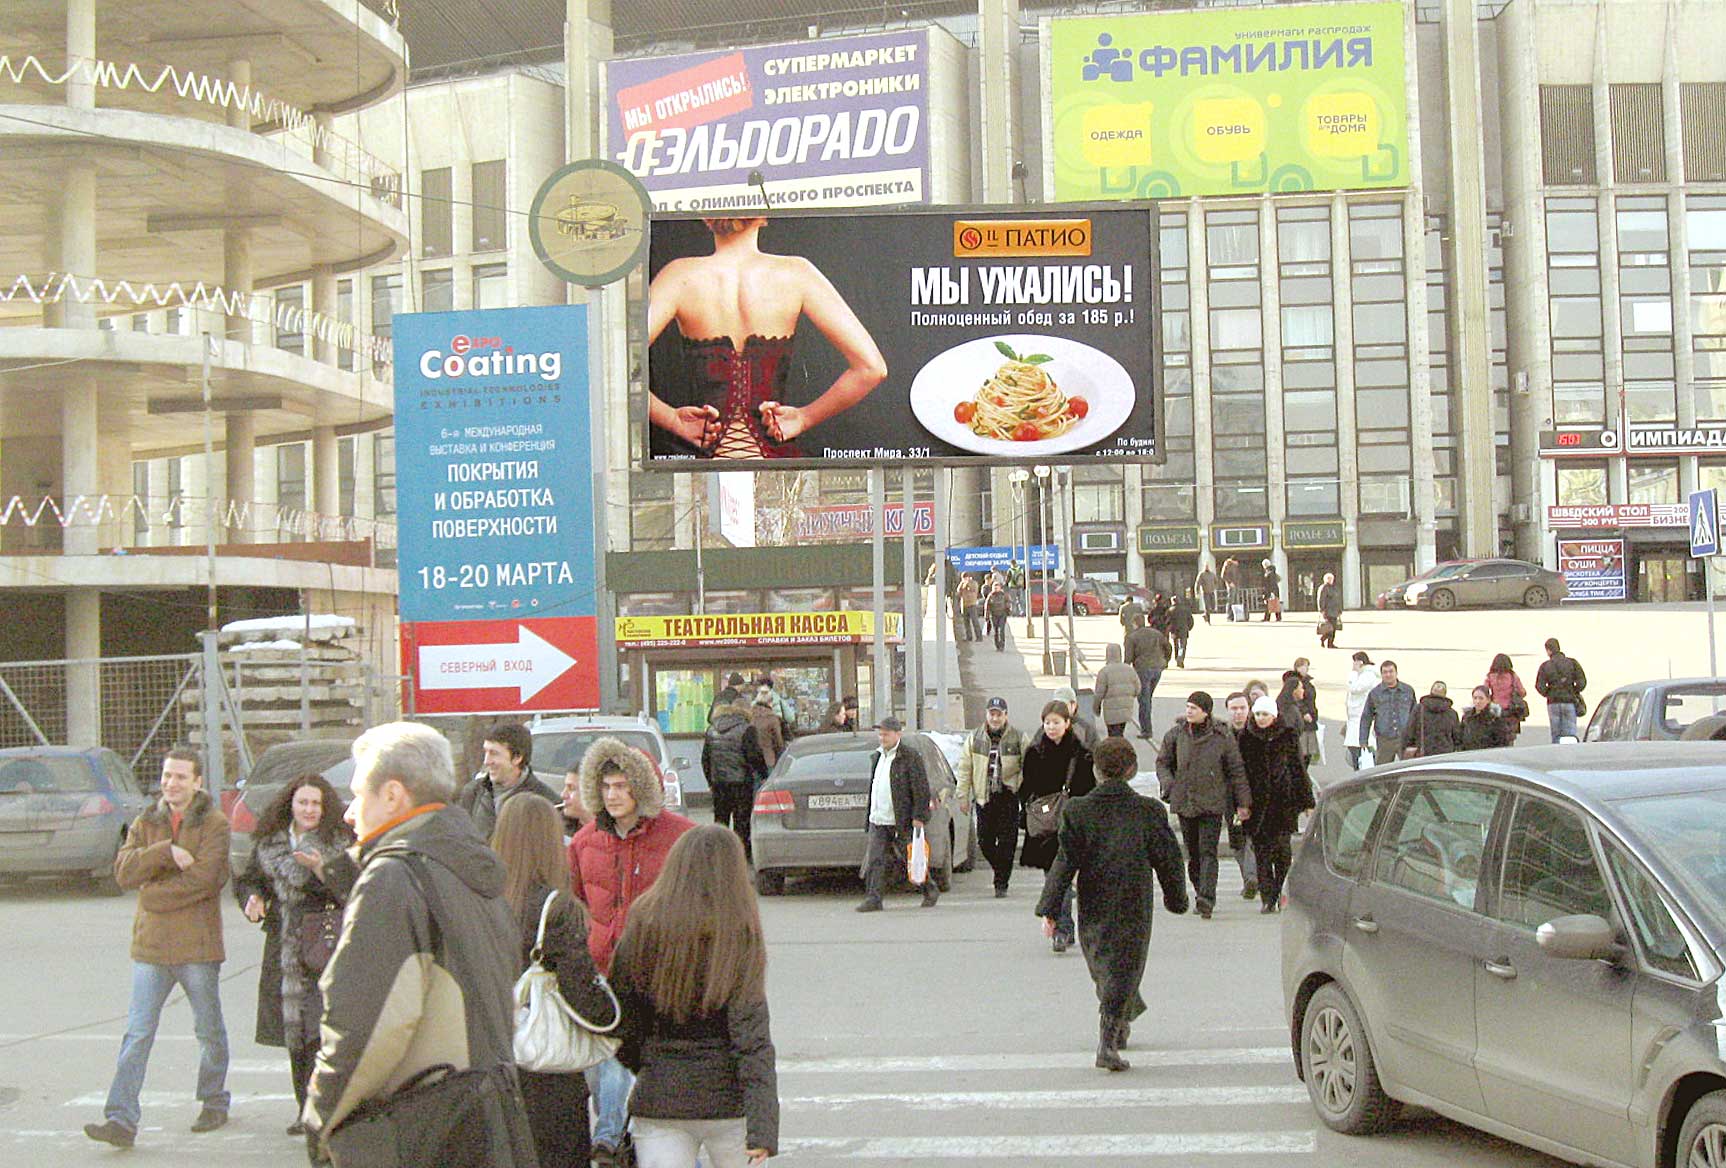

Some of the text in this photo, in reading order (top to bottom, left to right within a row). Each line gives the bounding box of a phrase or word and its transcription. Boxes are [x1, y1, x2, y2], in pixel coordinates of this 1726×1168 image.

[764, 45, 917, 76] СУПЕРМАРКЕТ
[1139, 37, 1373, 77] ФАМИЛИЯ
[764, 74, 920, 105] ЭЛЕКТРОНИКИ
[624, 72, 746, 130] МЫ ОТКРЫЛИСЬ!
[1317, 114, 1367, 124] ТОВАРЫ
[1090, 128, 1143, 141] ОДЕЖДА
[1206, 124, 1251, 137] ОБУВЬ
[1330, 124, 1366, 134] ДОМА
[691, 188, 818, 211] ОЛИМПИЙСКОГО
[822, 181, 914, 202] ПРОСПЕКТА
[1005, 227, 1086, 247] ПАТИО
[911, 265, 1133, 305] МЫ УЖАЛИСЬ!
[911, 309, 1011, 327] Полноценный
[1017, 309, 1051, 326] обед
[1058, 312, 1076, 324] за
[1081, 309, 1108, 324] 185
[419, 346, 561, 380] Coating
[420, 396, 561, 409] EXHIBITIONS
[464, 423, 543, 438] МЕЖДУНАРОДНАЯ
[429, 439, 556, 456] ВЫСТАВКА И КОНФЕРЕНЦИЯ
[823, 447, 871, 459] Проспект
[908, 447, 930, 458] 33/1
[448, 461, 538, 482] ПОКРЫТИЯ
[434, 488, 554, 510] И ОБРАБОТКА
[1552, 505, 1648, 519] ШВЕДСКИЙ СТОЛ
[1673, 506, 1689, 514] 200
[432, 516, 557, 538] ПОВЕРХНОСТИ
[1653, 515, 1689, 525] БИЗНЕ
[1580, 545, 1615, 555] ПИЦЦА
[1568, 561, 1596, 570] СУШИ
[418, 561, 574, 589] 18-20 МАРТА
[663, 614, 848, 636] ТЕАТРАЛЬНАЯ КАССА
[758, 636, 789, 644] СПРАВКИ
[440, 659, 534, 673] СЕВЕРНЫЙ ВХОД
